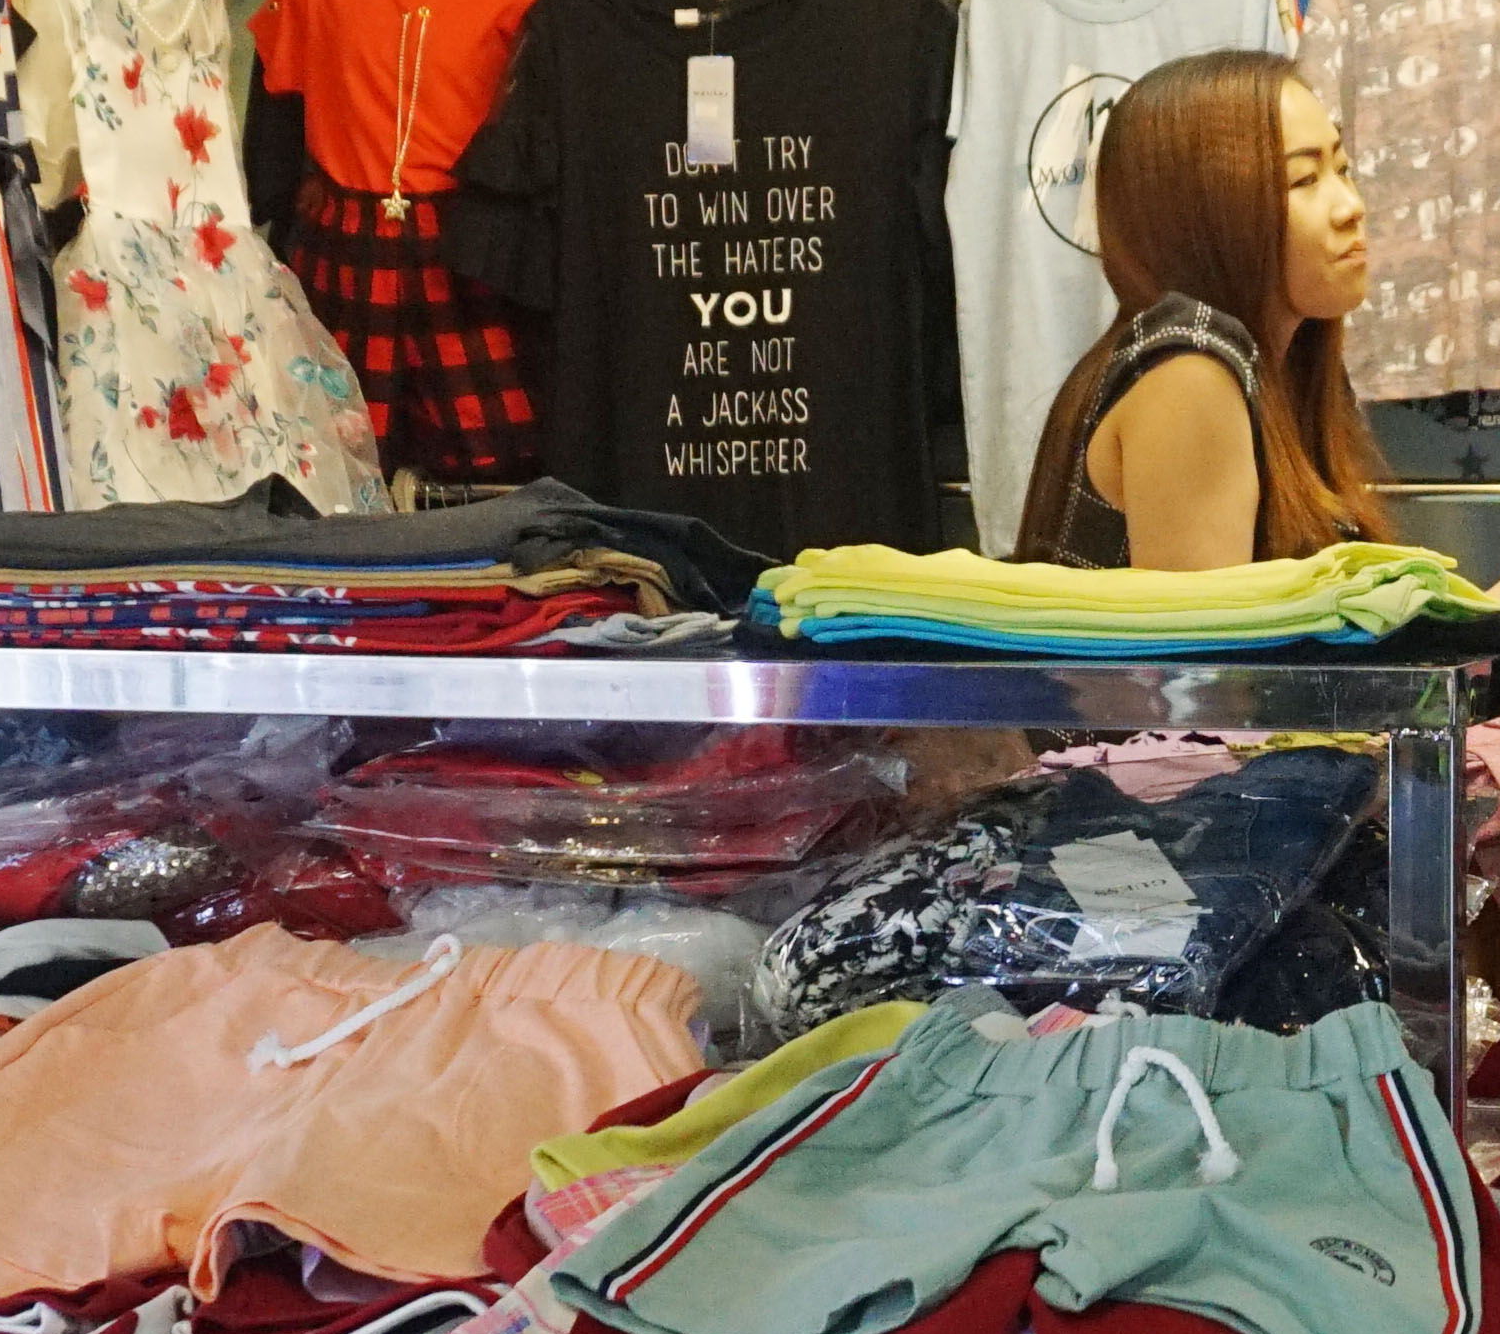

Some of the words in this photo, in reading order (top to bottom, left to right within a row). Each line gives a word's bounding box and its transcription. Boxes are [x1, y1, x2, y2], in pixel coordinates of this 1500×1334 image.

[763, 135, 812, 172] TRY
[643, 193, 680, 230] TO
[701, 186, 748, 224] WIN
[767, 186, 838, 223] OVER
[651, 242, 704, 280] THE
[724, 237, 825, 275] HATERS
[690, 288, 793, 329] YOU
[682, 340, 731, 378] ARE
[751, 335, 796, 375] NOT
[665, 393, 684, 428] A
[701, 386, 810, 428] JACKASS
